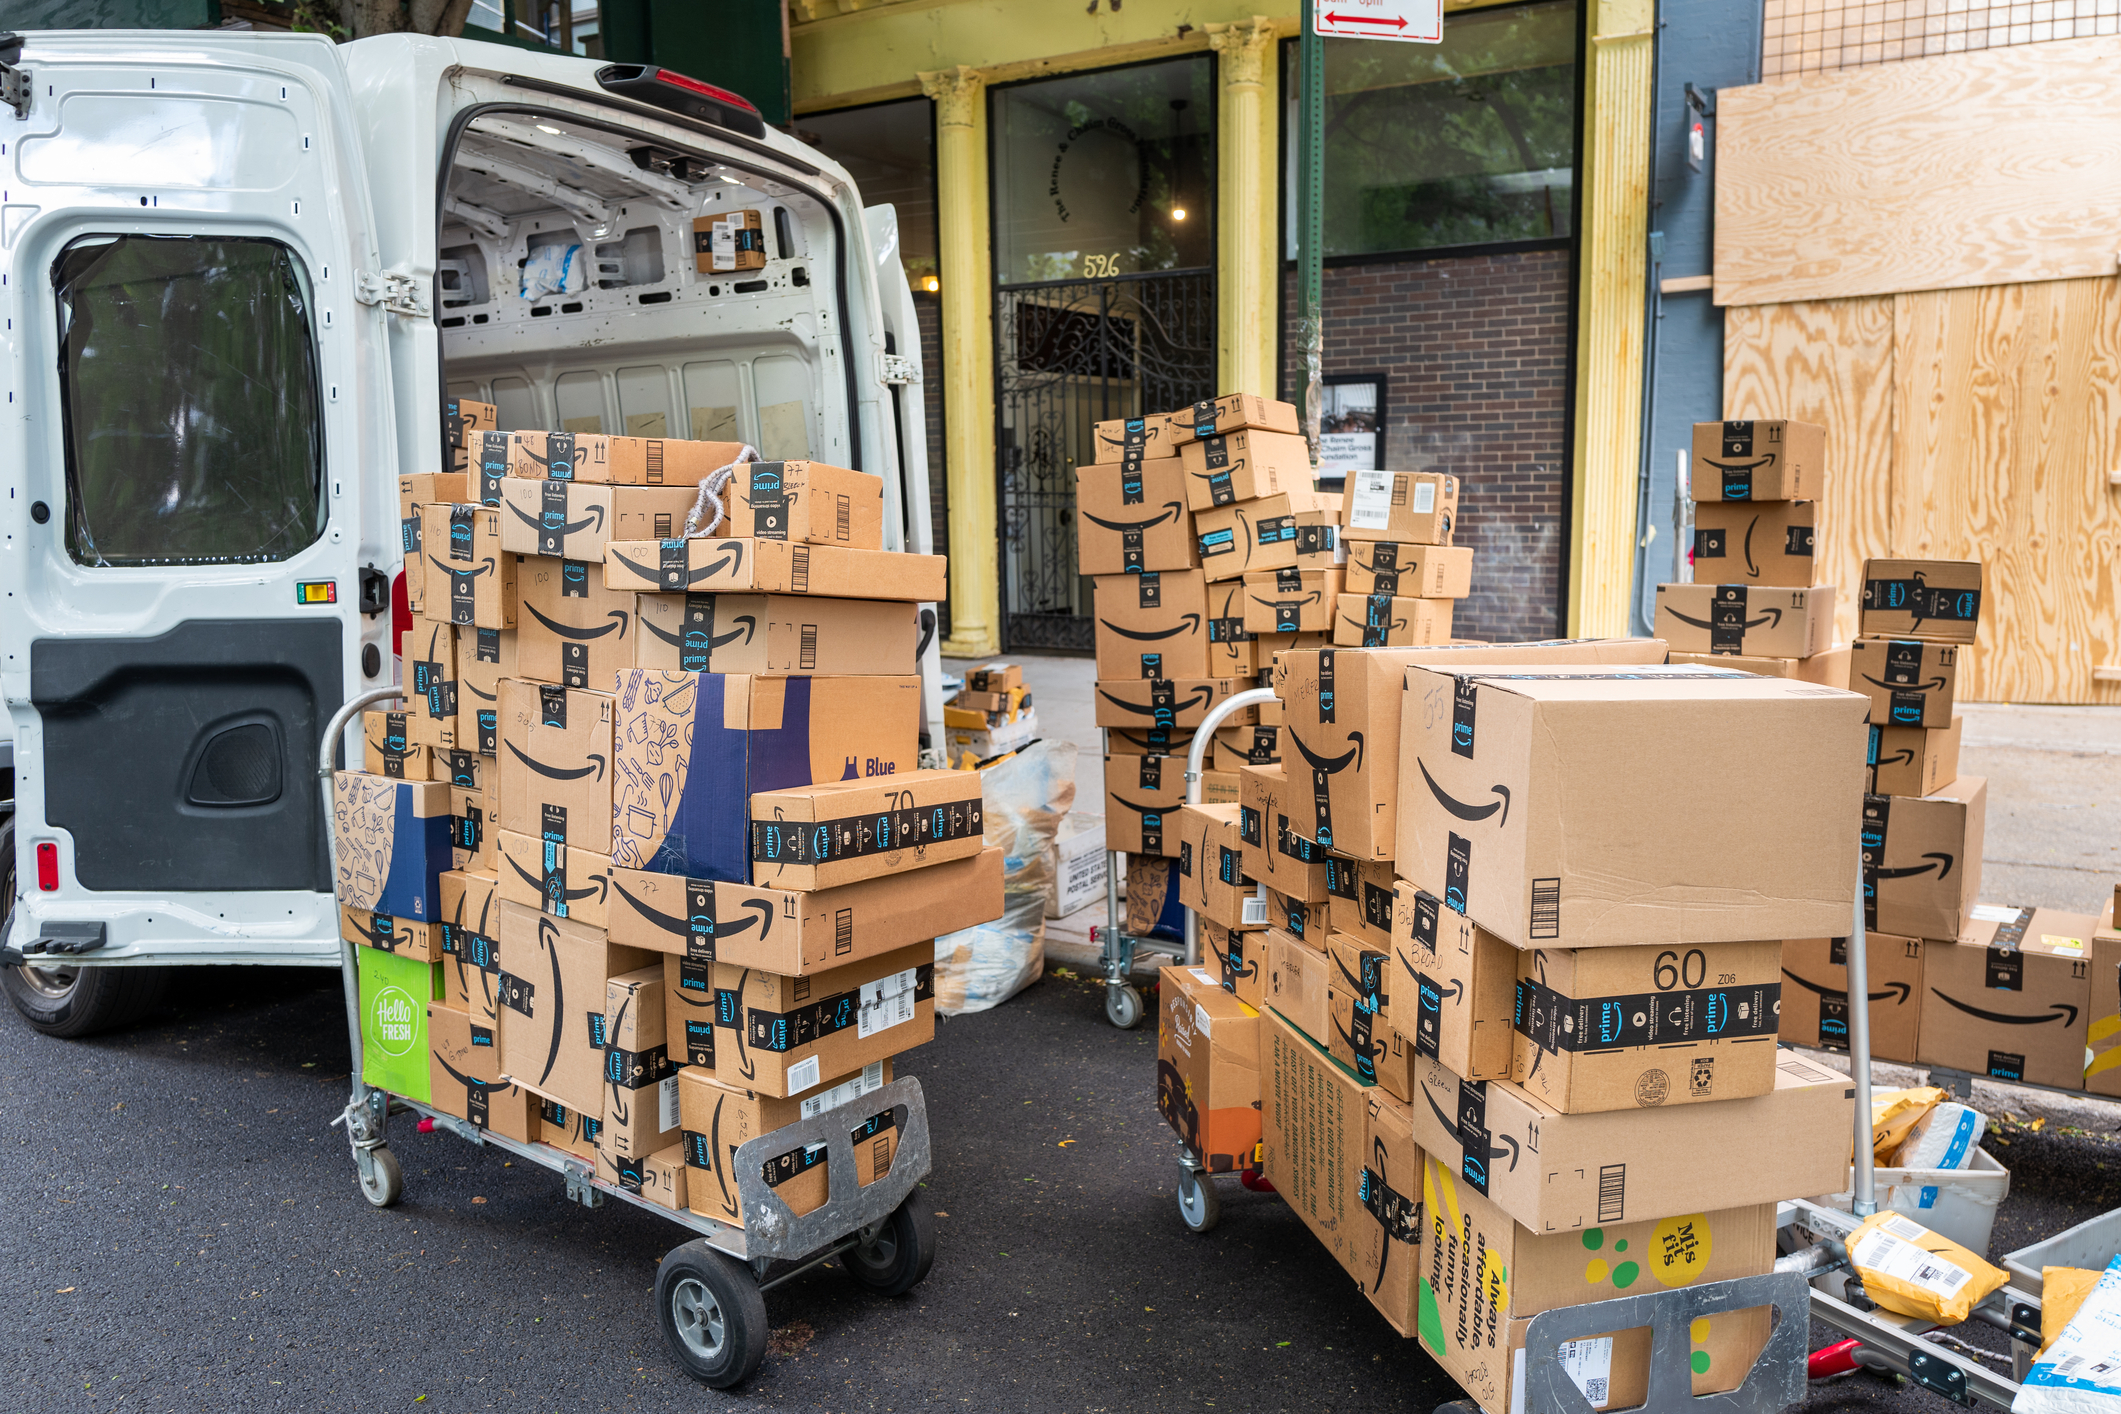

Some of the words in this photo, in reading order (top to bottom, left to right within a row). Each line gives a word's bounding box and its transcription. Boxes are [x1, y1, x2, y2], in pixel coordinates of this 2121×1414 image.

[1083, 253, 1120, 278] 526
[486, 461, 504, 471] prime
[551, 470, 571, 479] prime
[754, 480, 780, 492] prime
[1124, 481, 1141, 491] prime
[1725, 483, 1749, 492] prime
[544, 511, 564, 521] prime
[451, 531, 470, 542] prime
[565, 564, 584, 574] prime
[1964, 592, 1973, 618] prime
[685, 639, 708, 651] prime
[684, 655, 706, 665] prime
[1894, 706, 1921, 715] prime
[1454, 721, 1472, 737] prime
[389, 735, 405, 744] prime
[866, 757, 895, 777] Blue
[881, 816, 890, 847] prime
[936, 808, 945, 838] prime
[544, 831, 564, 842] prime
[820, 826, 829, 859] prime
[1328, 859, 1336, 891] prime
[1446, 894, 1464, 914] prime
[376, 918, 392, 928] prime
[691, 924, 713, 935] prime
[443, 925, 451, 951] prime
[1653, 949, 1707, 991] 60
[1718, 973, 1736, 985] Z06
[684, 978, 705, 989] prime
[1420, 984, 1439, 1004] prime
[377, 999, 411, 1027] Hello
[721, 991, 729, 1022] prime
[1515, 985, 1523, 1025] prime
[1705, 993, 1717, 1033] prime
[689, 1025, 711, 1035] prime
[1599, 1002, 1611, 1043] prime
[1821, 1023, 1846, 1036] prime
[382, 1024, 411, 1041] FRESH
[778, 1019, 786, 1050] prime
[1274, 1059, 1280, 1067] A
[1356, 1053, 1372, 1067] prime
[1991, 1067, 2019, 1079] prime
[1327, 1102, 1334, 1116] IN
[1327, 1116, 1334, 1125] A
[696, 1136, 705, 1166] prime
[1309, 1152, 1316, 1165] IN
[1464, 1164, 1485, 1186] prime
[1327, 1158, 1335, 1213] WORKOUT
[1662, 1233, 1685, 1267] fits
[1678, 1221, 1699, 1264] Mis
[1430, 1215, 1445, 1295] looking.
[1447, 1234, 1458, 1304] funny-
[1456, 1213, 1472, 1350] occasionally
[1470, 1232, 1487, 1351] affordable,
[1487, 1269, 1501, 1349] Always
